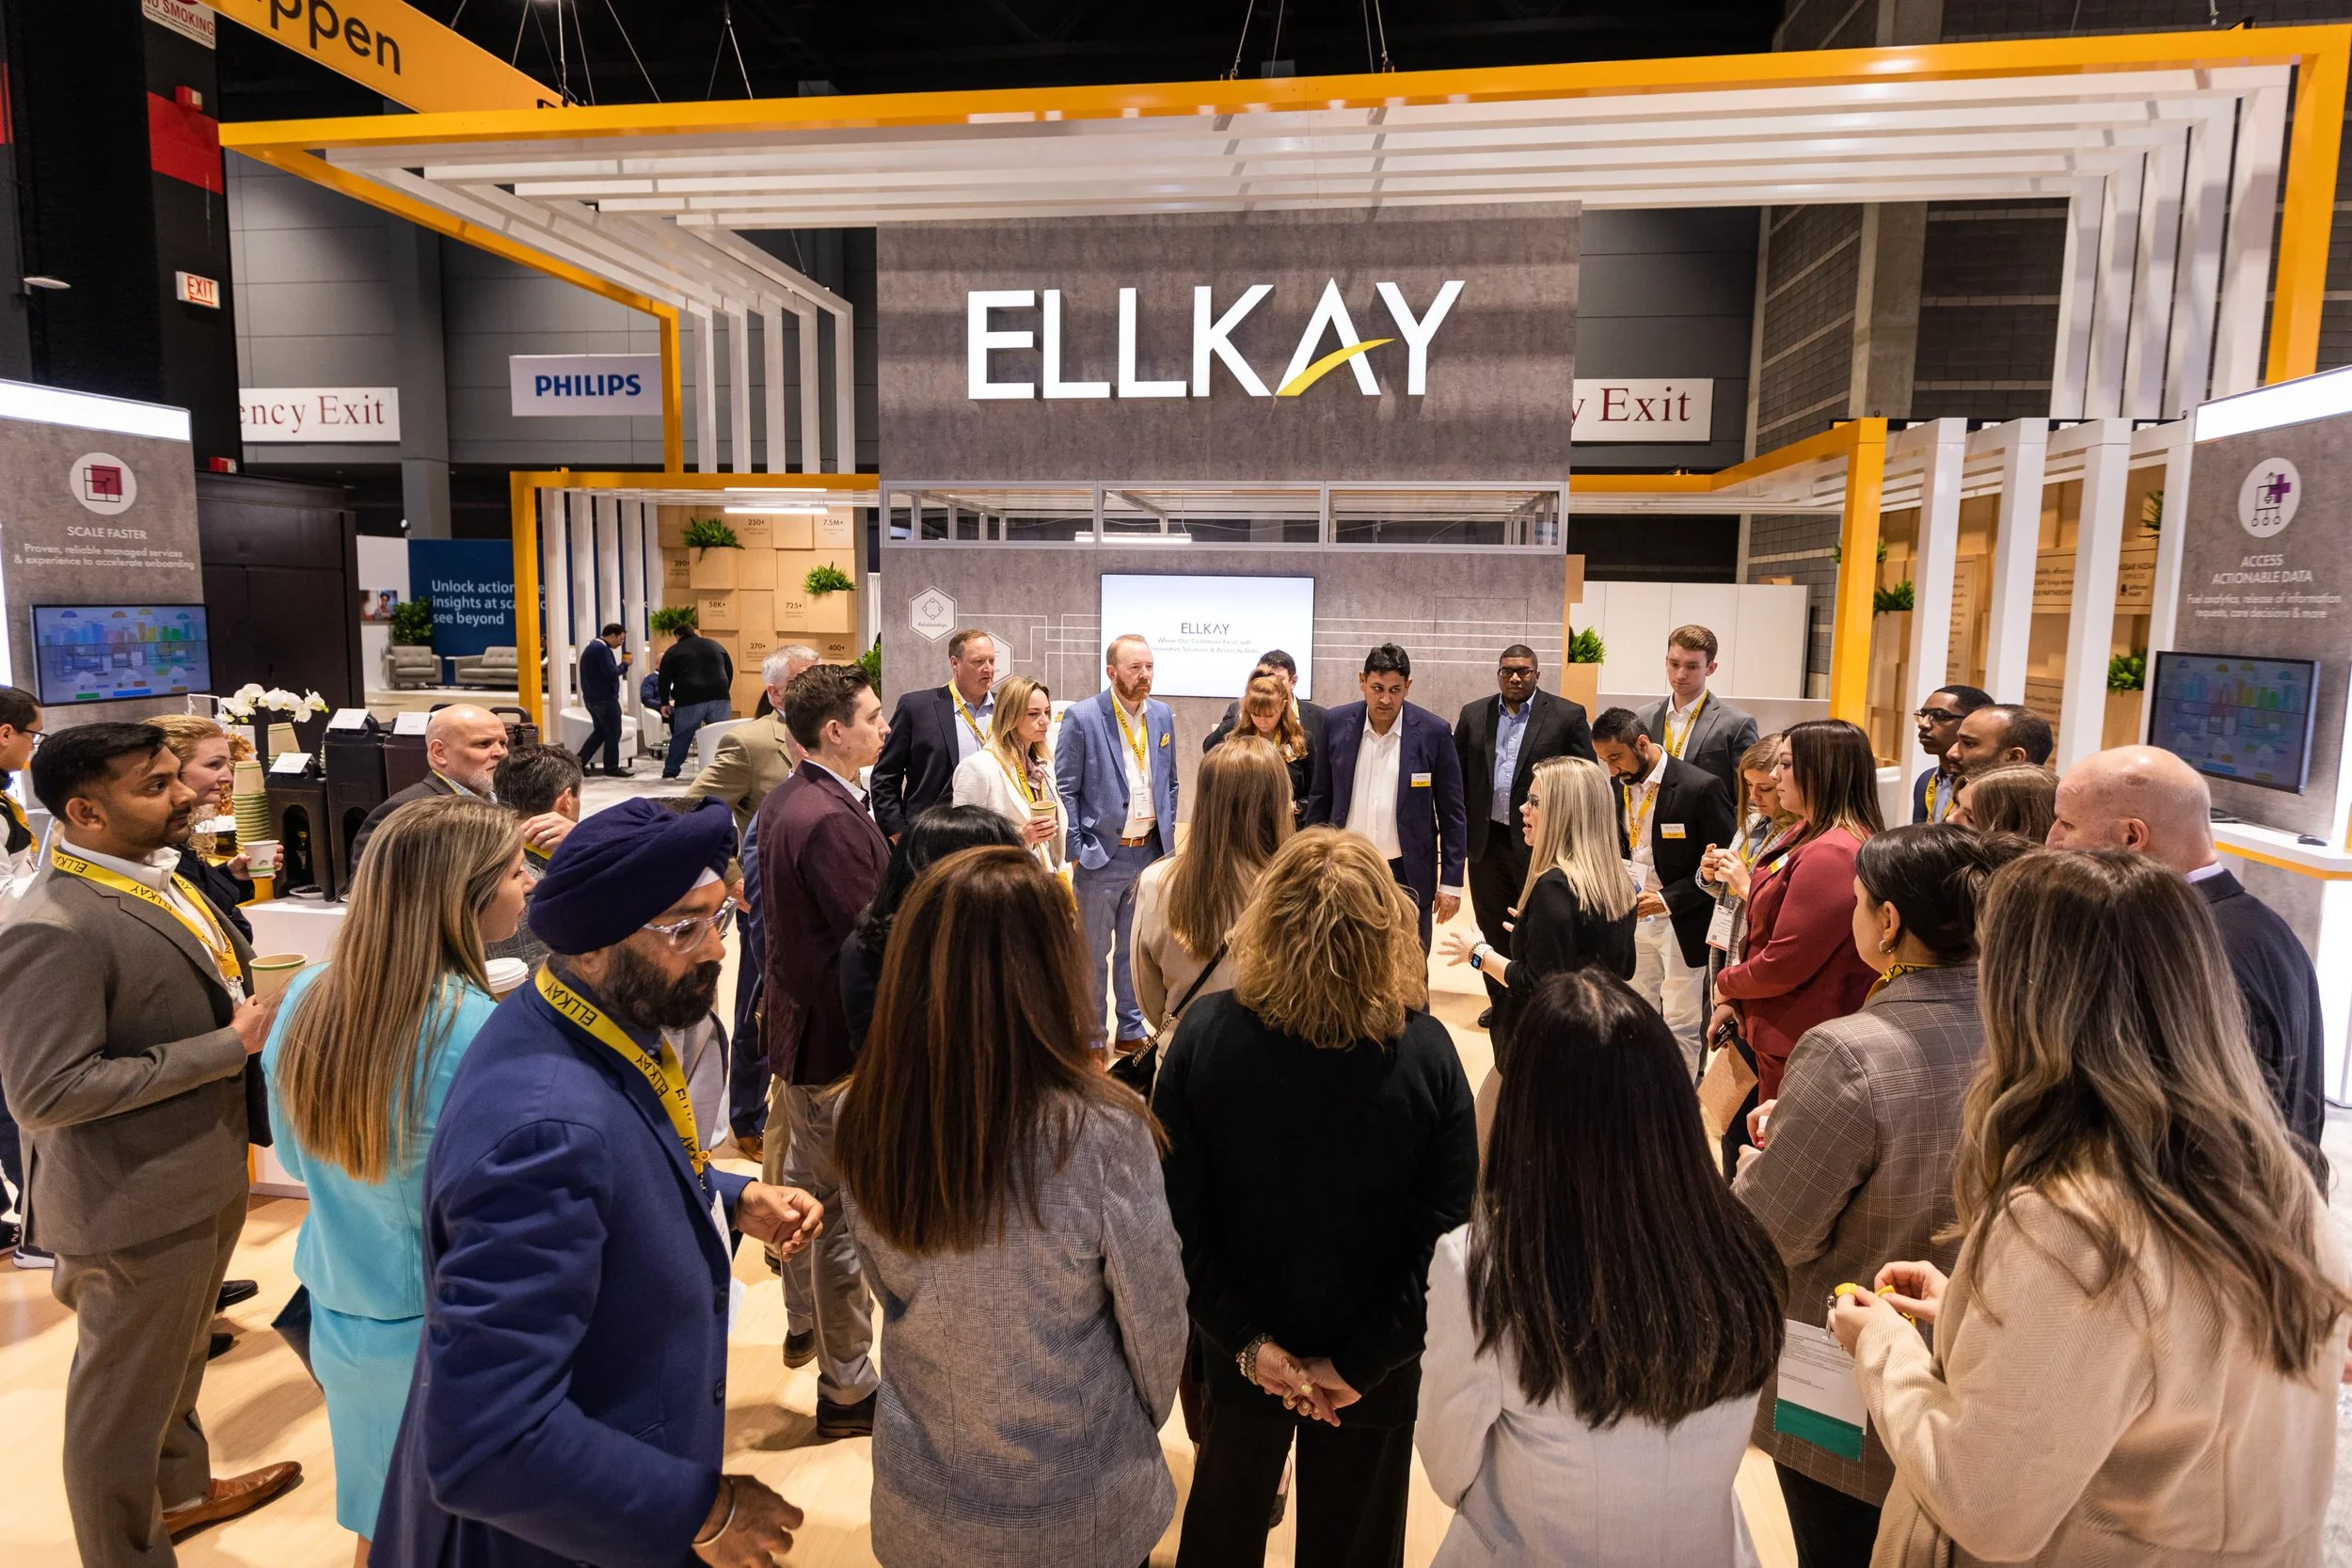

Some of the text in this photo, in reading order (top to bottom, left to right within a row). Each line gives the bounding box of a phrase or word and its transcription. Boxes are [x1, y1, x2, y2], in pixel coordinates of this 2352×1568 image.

[163, 0, 214, 36] SMOKING
[258, 0, 401, 75] ppen
[187, 275, 215, 300] EXIT
[968, 277, 1466, 400] ELLKAY
[534, 373, 642, 397] PHILIPS
[317, 394, 384, 425] Exit
[1597, 386, 1692, 421] Exit
[67, 526, 148, 540] SCALE FASTER
[65, 546, 102, 555] reliable
[103, 547, 147, 558] managed
[149, 549, 183, 558] services
[14, 555, 195, 571] & experience to accelerate onboarding
[2240, 554, 2284, 567] ACCESS
[2212, 570, 2314, 584] ACTIONABLE DATA
[432, 579, 474, 594] Unlock
[433, 595, 481, 610] insights
[485, 597, 497, 610] at
[2243, 594, 2273, 604] release
[2275, 592, 2287, 603] of
[2287, 592, 2342, 604] information
[433, 612, 504, 627] see beyond
[2250, 608, 2290, 618] decisions
[2302, 610, 2328, 618] more
[1181, 623, 1230, 635] ELLKAY
[544, 981, 598, 1026] ELLKAY
[635, 1053, 669, 1098] ELLKAY
